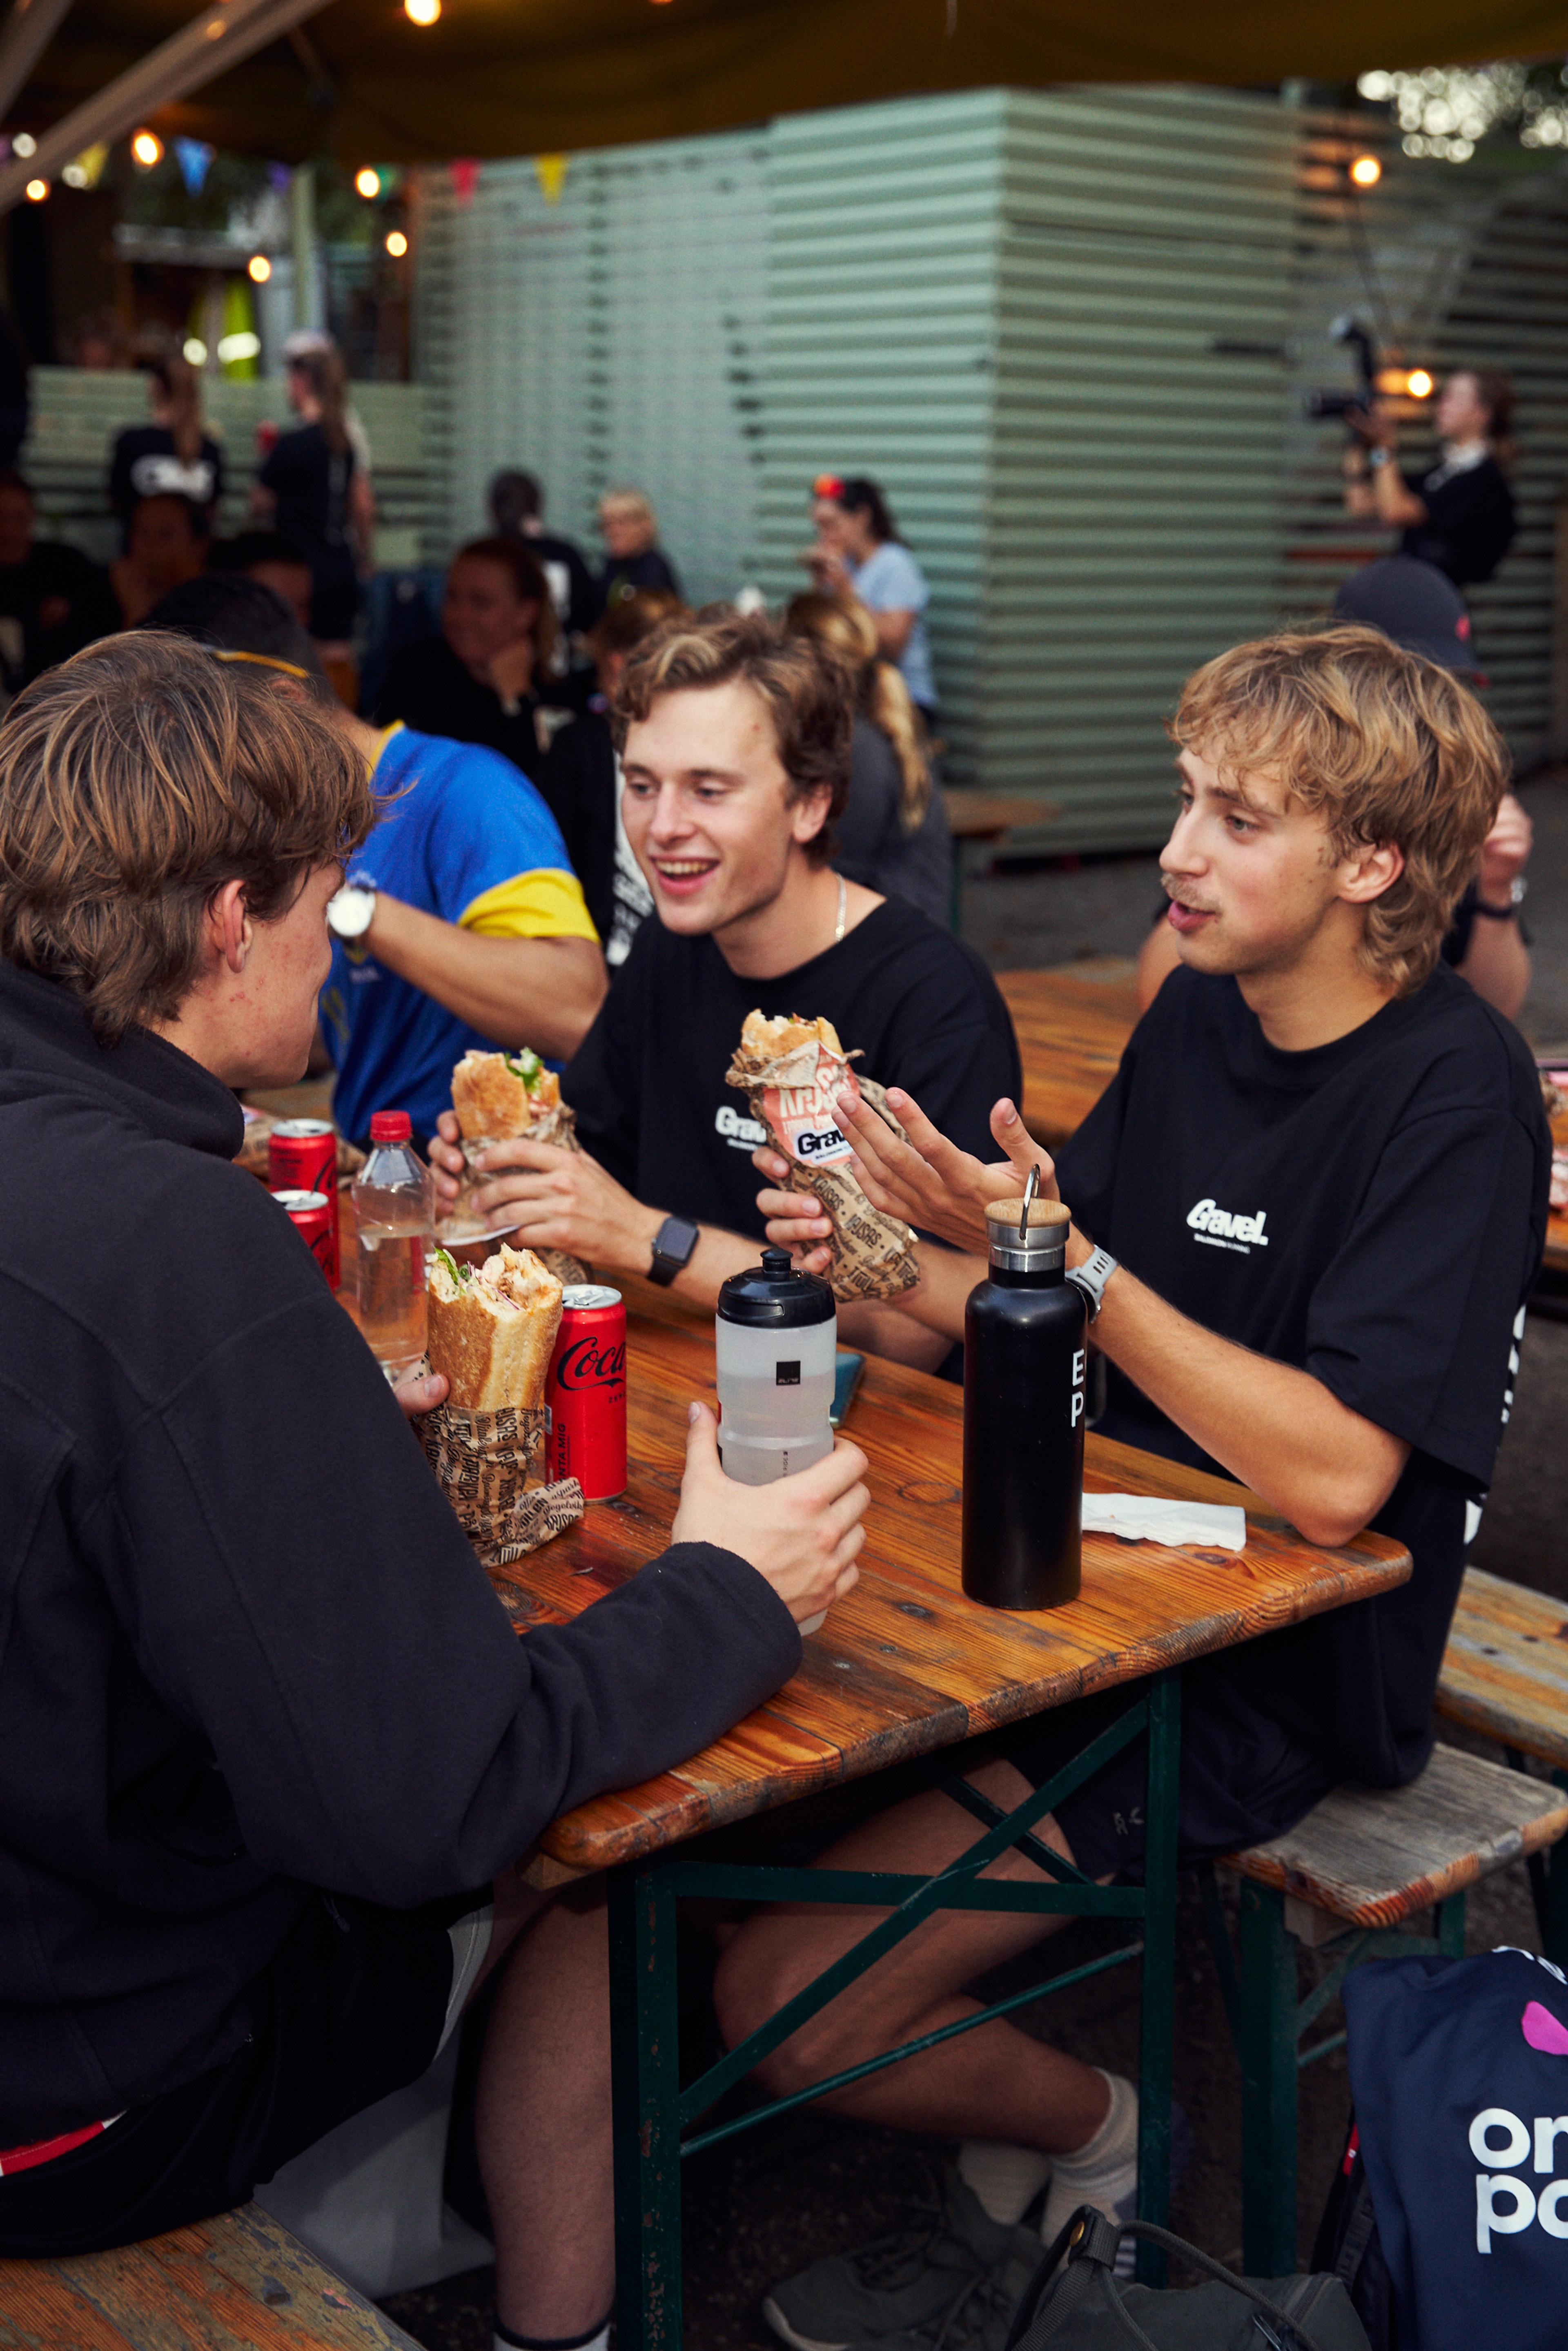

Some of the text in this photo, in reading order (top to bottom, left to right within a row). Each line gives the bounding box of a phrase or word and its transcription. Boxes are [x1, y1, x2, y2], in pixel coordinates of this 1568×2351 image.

[715, 1106, 767, 1143] Grav
[797, 1130, 845, 1155] Grav
[608, 1391, 626, 1403] ZER
[495, 1407, 518, 1442] AJSAS
[557, 1424, 566, 1476] NTA MIG
